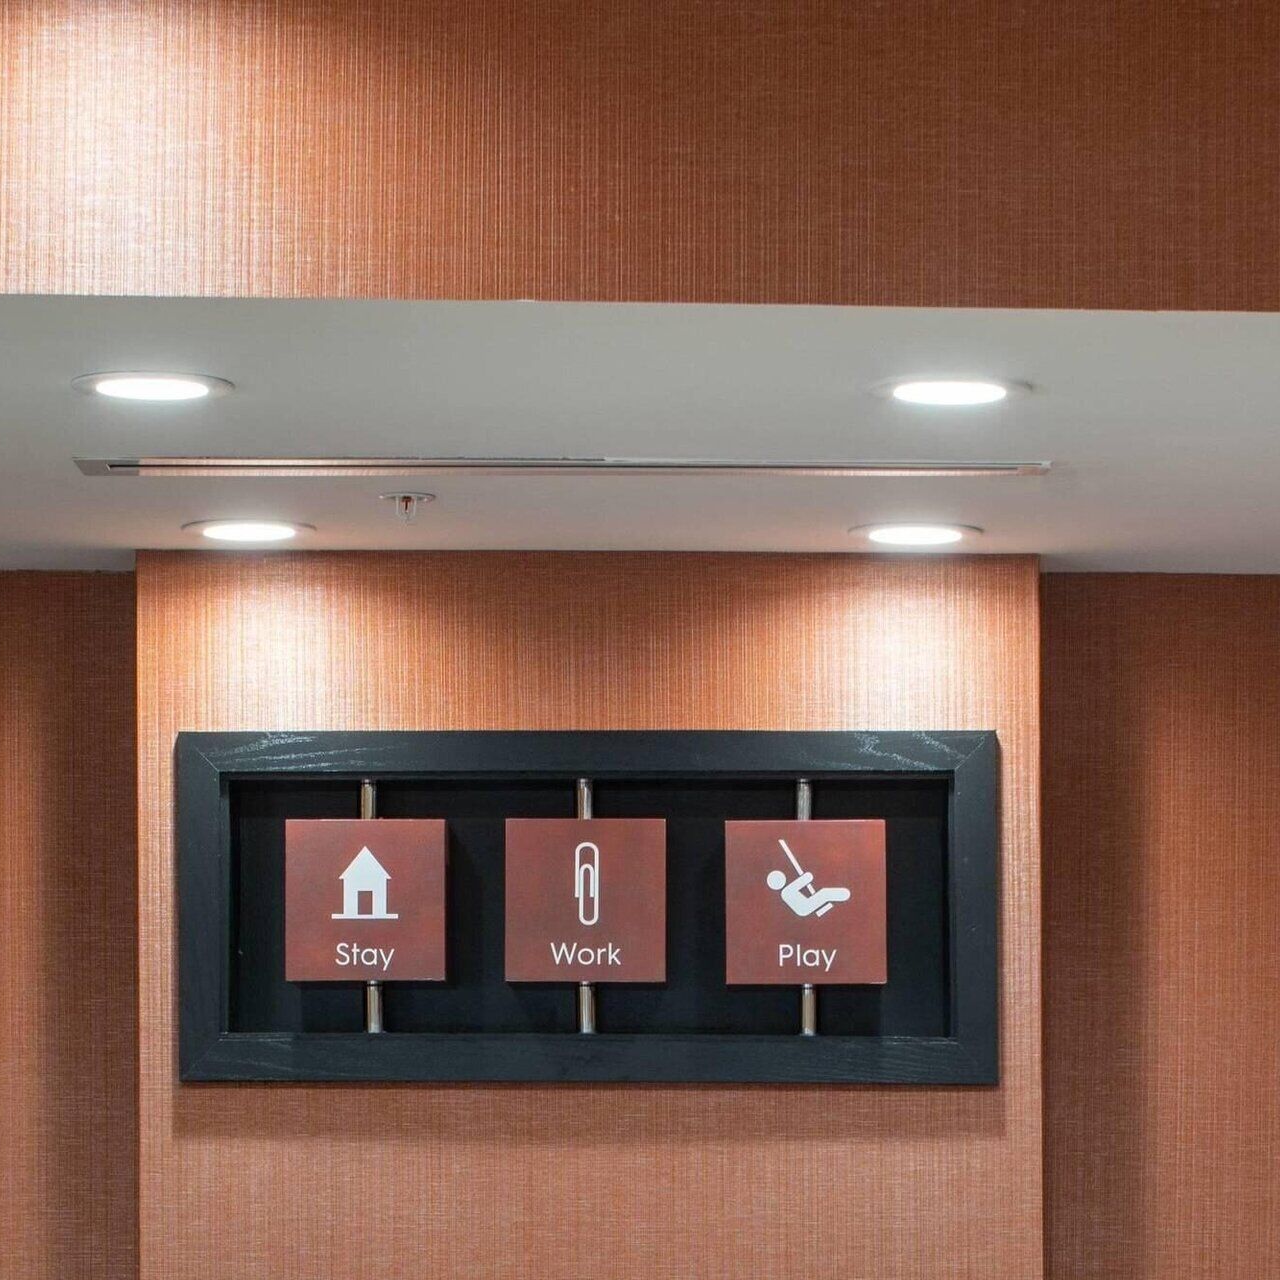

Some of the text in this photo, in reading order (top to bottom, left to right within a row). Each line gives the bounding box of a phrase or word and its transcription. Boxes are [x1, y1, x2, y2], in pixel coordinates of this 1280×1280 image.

[336, 943, 394, 971] Stay
[551, 943, 621, 965] Work
[779, 944, 836, 971] Play
